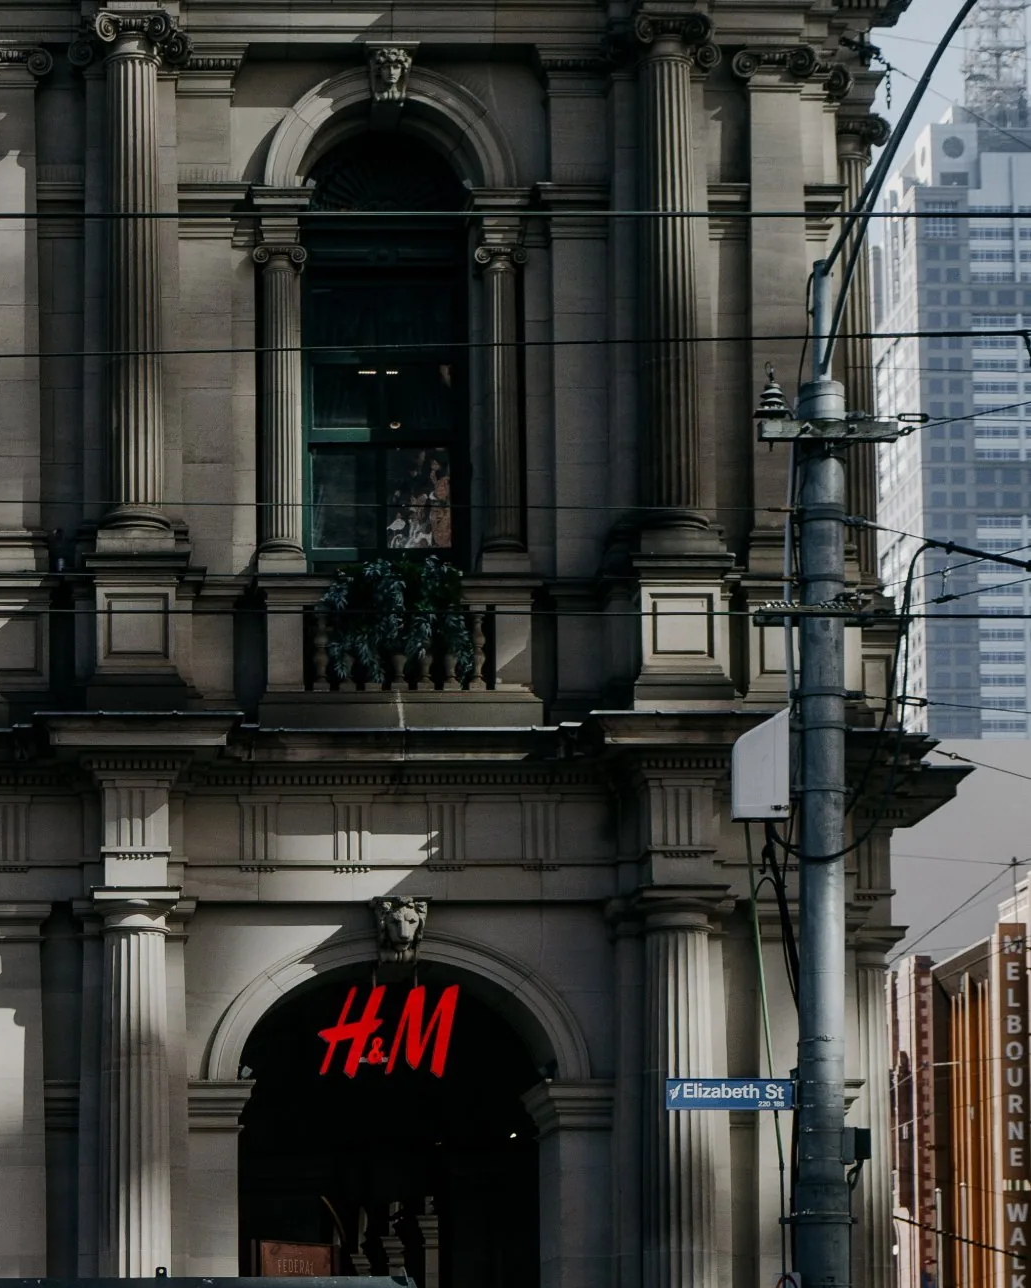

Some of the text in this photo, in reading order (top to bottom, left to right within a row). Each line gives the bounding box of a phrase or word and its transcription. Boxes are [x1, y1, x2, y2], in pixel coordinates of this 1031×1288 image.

[318, 984, 460, 1079] H&M
[1003, 934, 1025, 1167] MELBOURNE
[683, 1082, 785, 1100] Elizabeth St
[277, 1258, 315, 1275] FEDERAL
